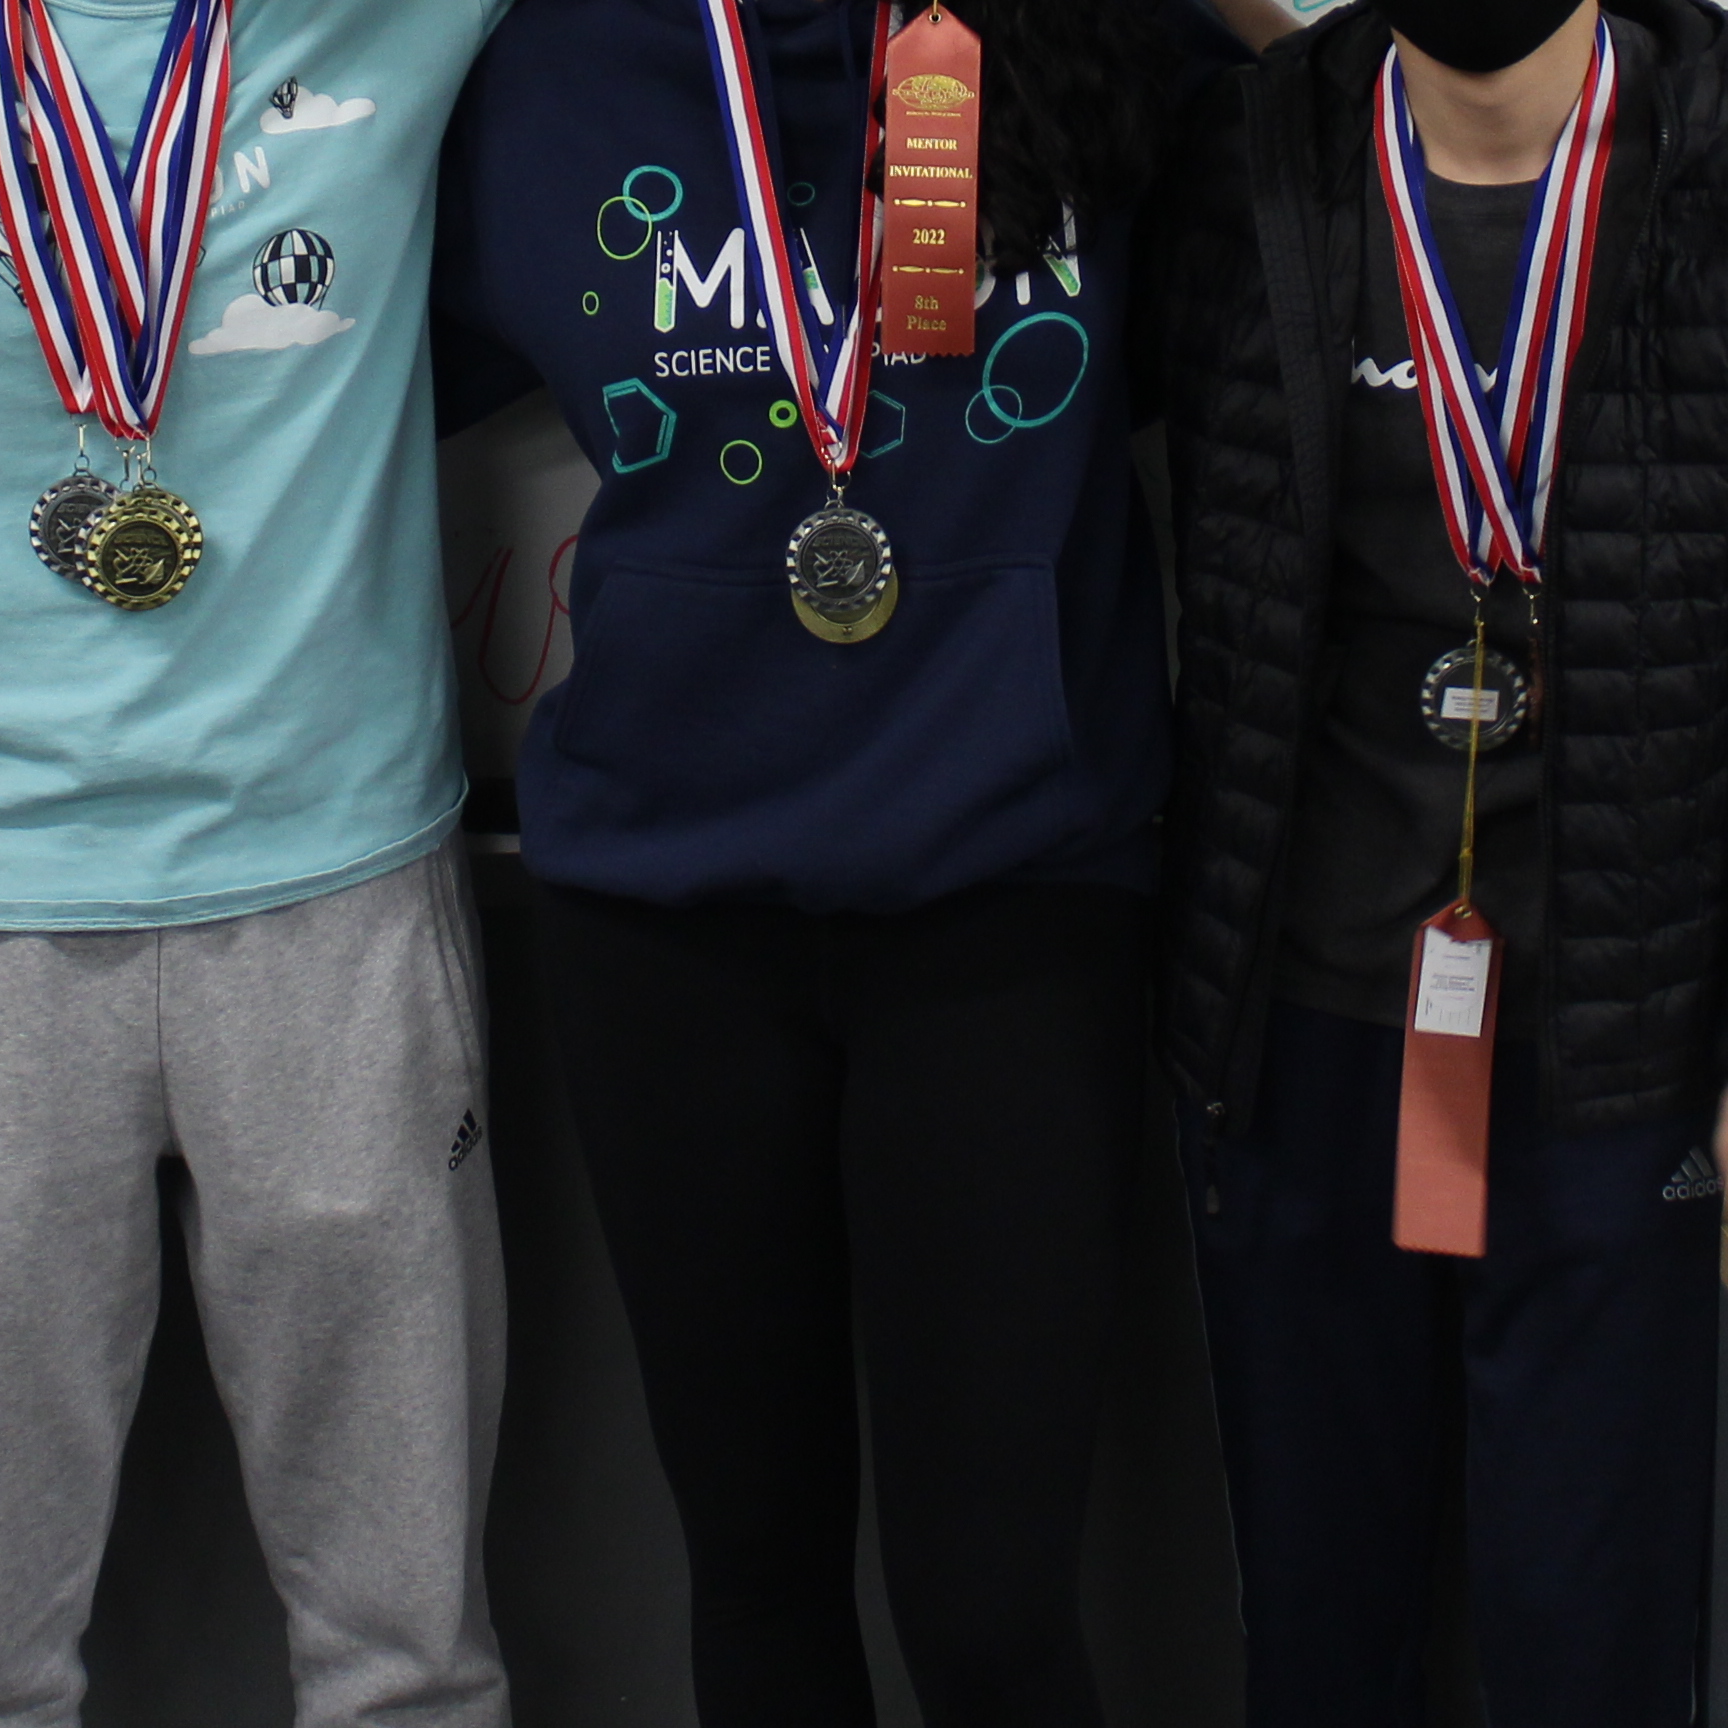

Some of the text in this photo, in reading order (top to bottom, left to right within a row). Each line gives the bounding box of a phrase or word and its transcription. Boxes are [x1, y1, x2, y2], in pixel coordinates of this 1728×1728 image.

[906, 137, 958, 151] MENTOR
[889, 164, 972, 179] INVITATIONAL
[912, 229, 946, 245] 2022
[914, 296, 939, 310] 8th
[906, 315, 947, 331] Place
[654, 346, 771, 377] SCIENCE
